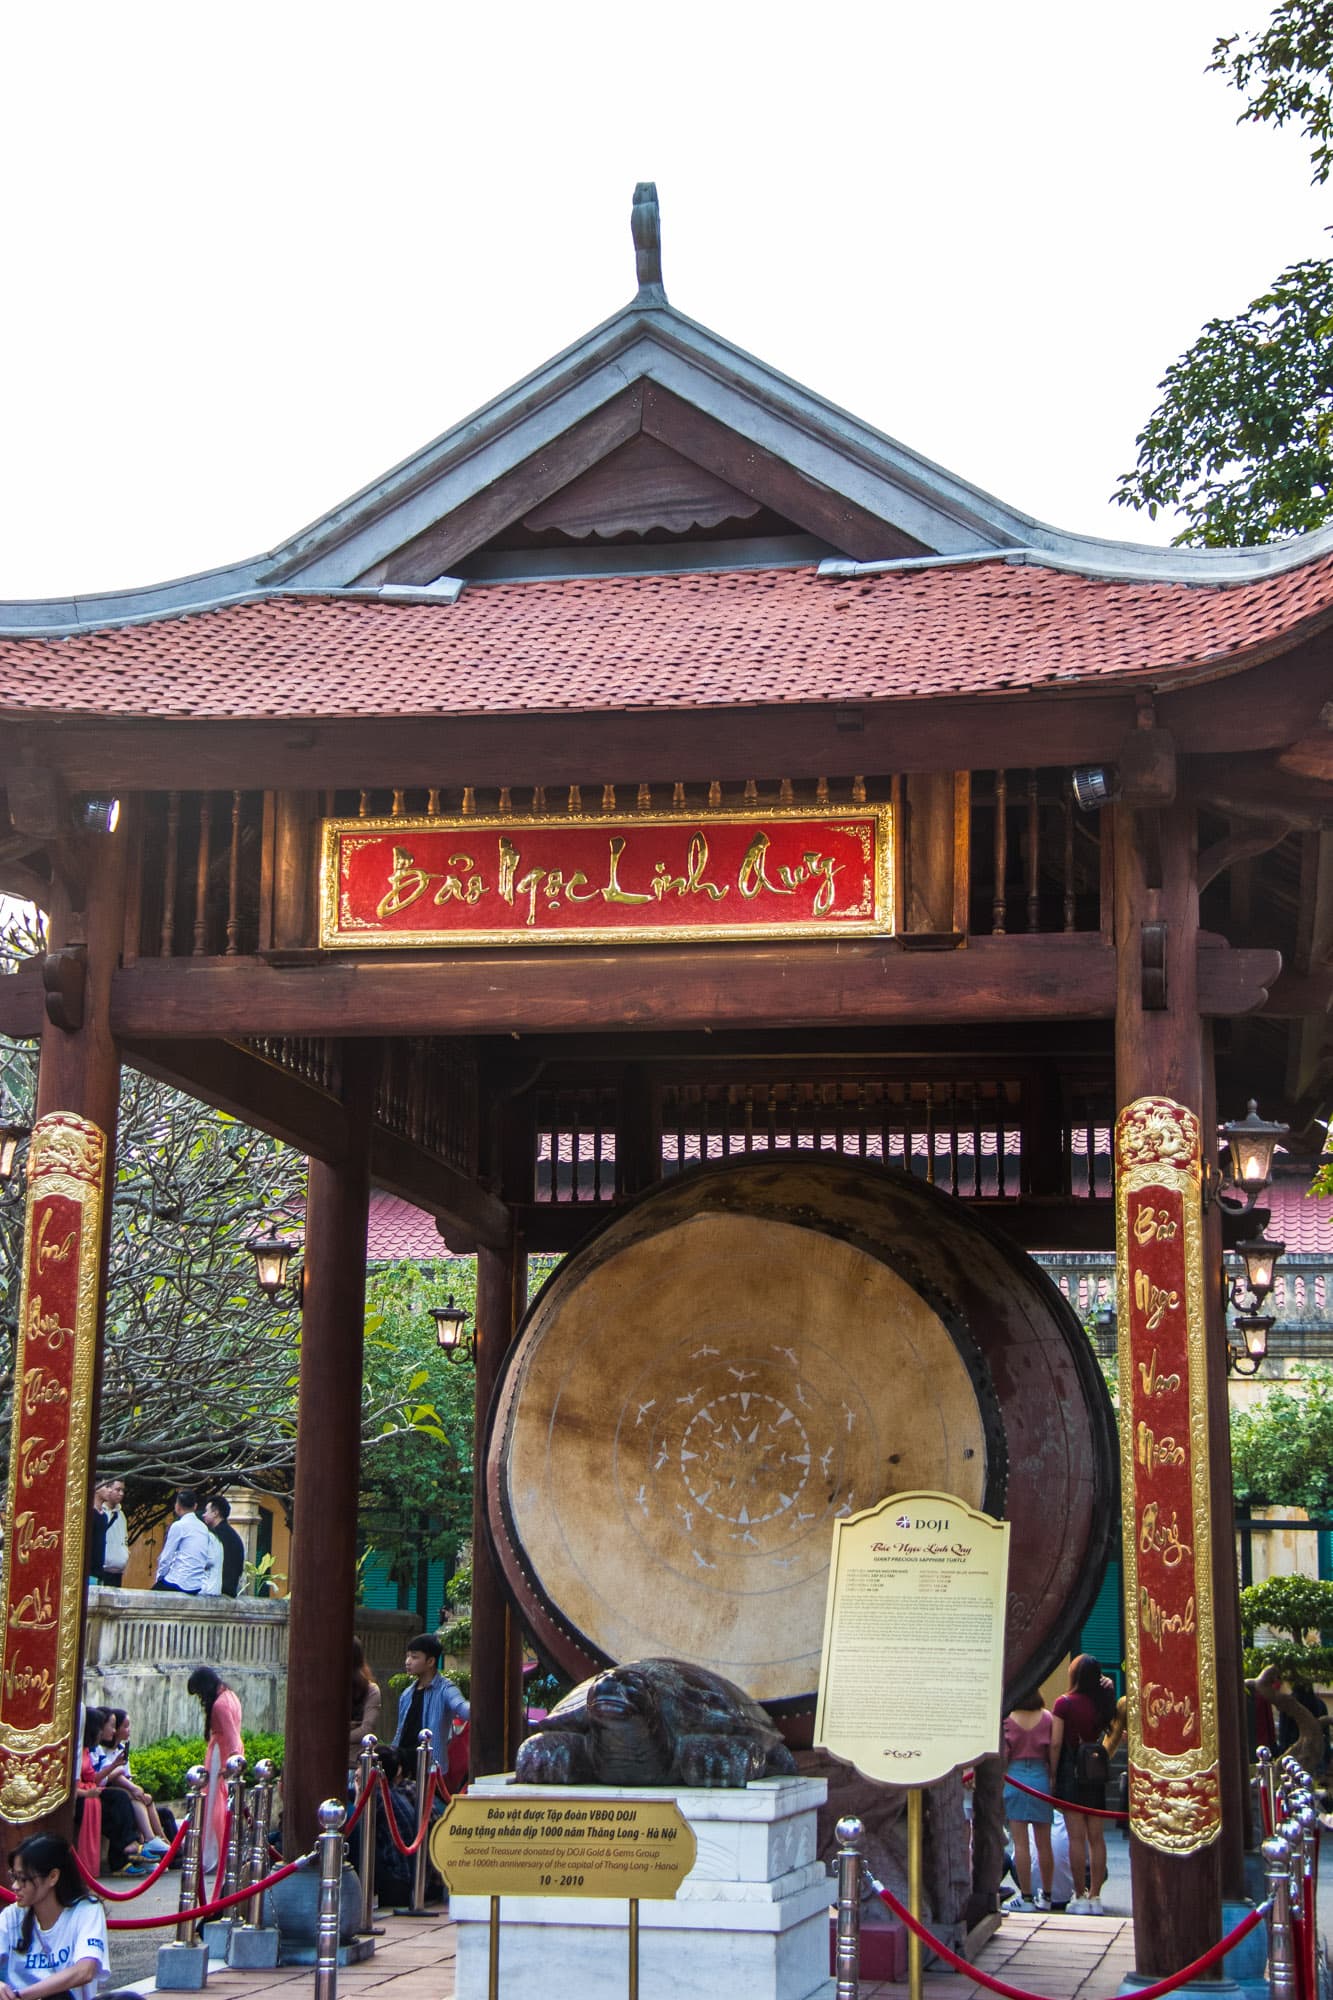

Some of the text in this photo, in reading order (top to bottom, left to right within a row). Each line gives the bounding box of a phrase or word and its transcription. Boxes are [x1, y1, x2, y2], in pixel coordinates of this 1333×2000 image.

[376, 831, 846, 926] Bảo Ngọc Linh Quy
[915, 1519, 950, 1533] DOJI
[487, 1808, 505, 1820] Bảo
[506, 1809, 522, 1822] vật
[523, 1809, 545, 1822] được
[547, 1809, 562, 1823] Tập
[564, 1809, 588, 1821] đoàn
[616, 1810, 637, 1821] DOJI
[449, 1825, 474, 1838] Dâng
[475, 1826, 496, 1840] tặng
[497, 1826, 522, 1837] nhân
[523, 1825, 538, 1840] dịp
[541, 1826, 563, 1837] 1000
[617, 1828, 640, 1841] Long
[646, 1828, 660, 1839] Hà
[661, 1828, 678, 1841] Nội
[463, 1846, 660, 1860] Sacred Treasure donated by DOJI Gold & Gems Group
[447, 1860, 457, 1868] on
[458, 1859, 471, 1868] the
[473, 1859, 499, 1868] 1000th
[500, 1860, 544, 1870] anniversary
[545, 1860, 554, 1869] of
[554, 1860, 565, 1869] the
[567, 1861, 594, 1871] capital
[594, 1861, 604, 1870] of
[604, 1861, 629, 1872] Thang
[630, 1862, 649, 1872] Long
[655, 1862, 679, 1871] Hanoi
[540, 1875, 552, 1886] 10
[560, 1875, 585, 1887] 2010
